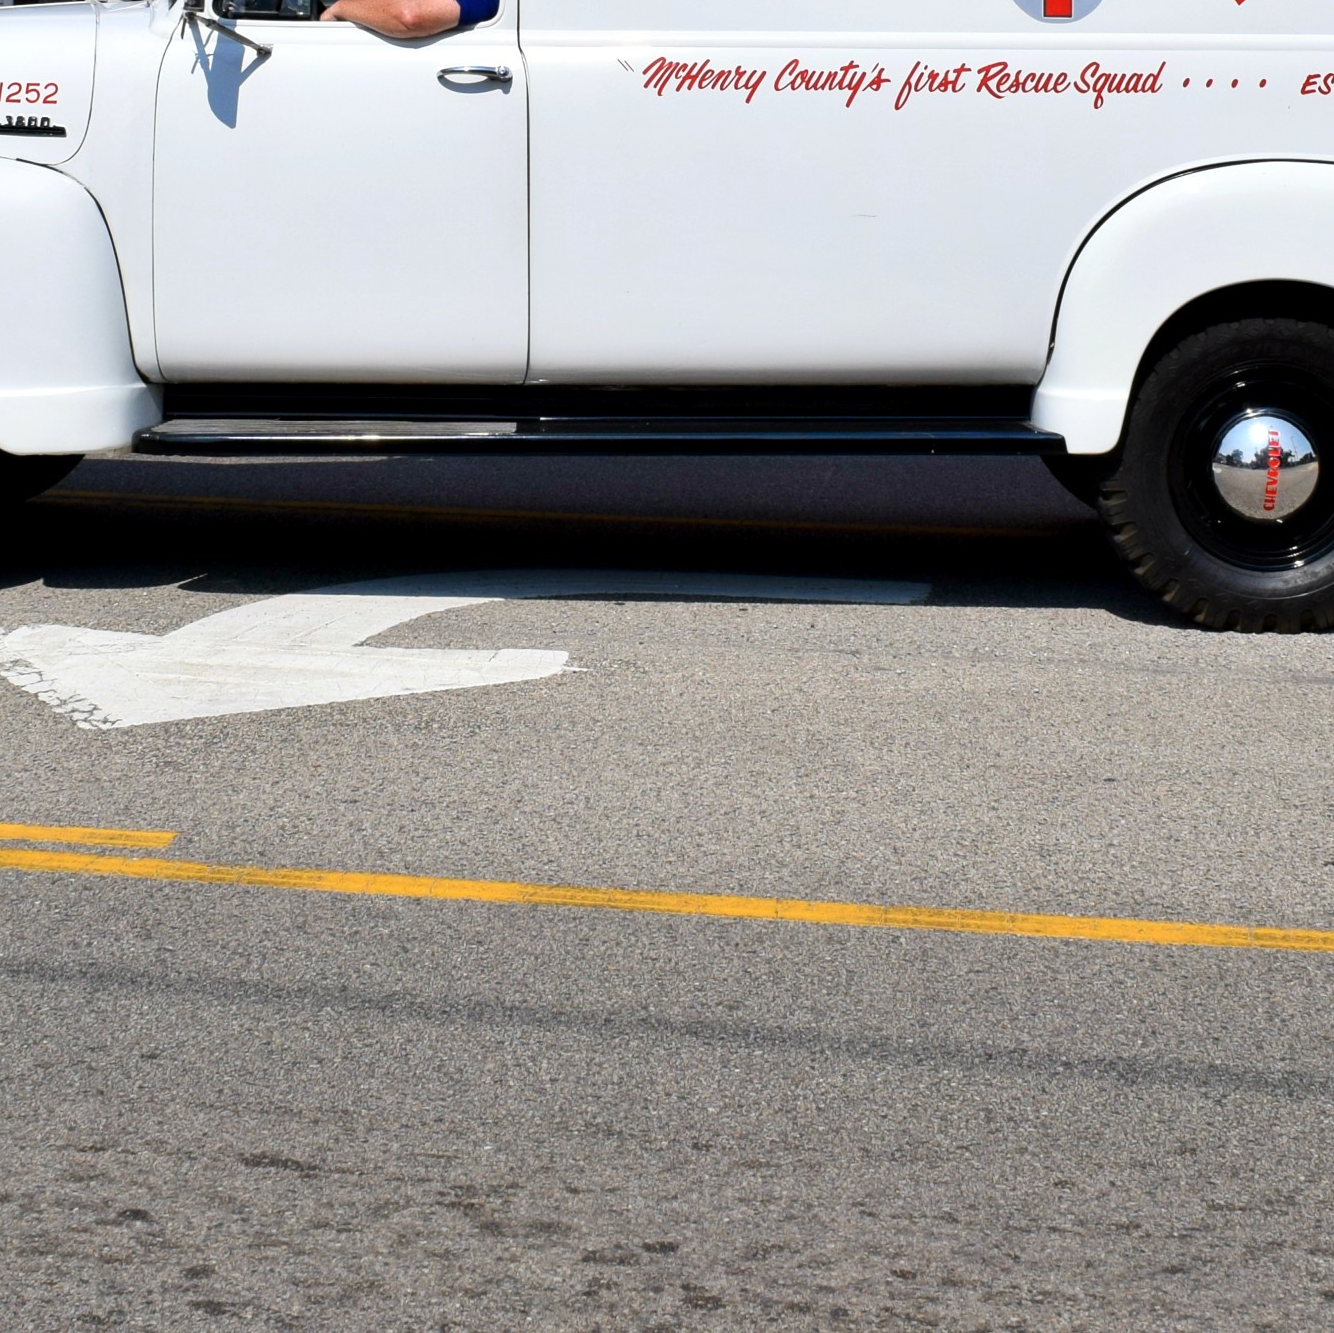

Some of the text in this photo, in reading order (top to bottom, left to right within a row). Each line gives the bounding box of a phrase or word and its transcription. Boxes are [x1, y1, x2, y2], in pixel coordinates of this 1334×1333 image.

[773, 58, 891, 108] County's
[893, 60, 972, 111] first
[976, 60, 1071, 100] Rescue
[1073, 60, 1167, 110] Squad
[1262, 430, 1281, 512] CHEVROLET
